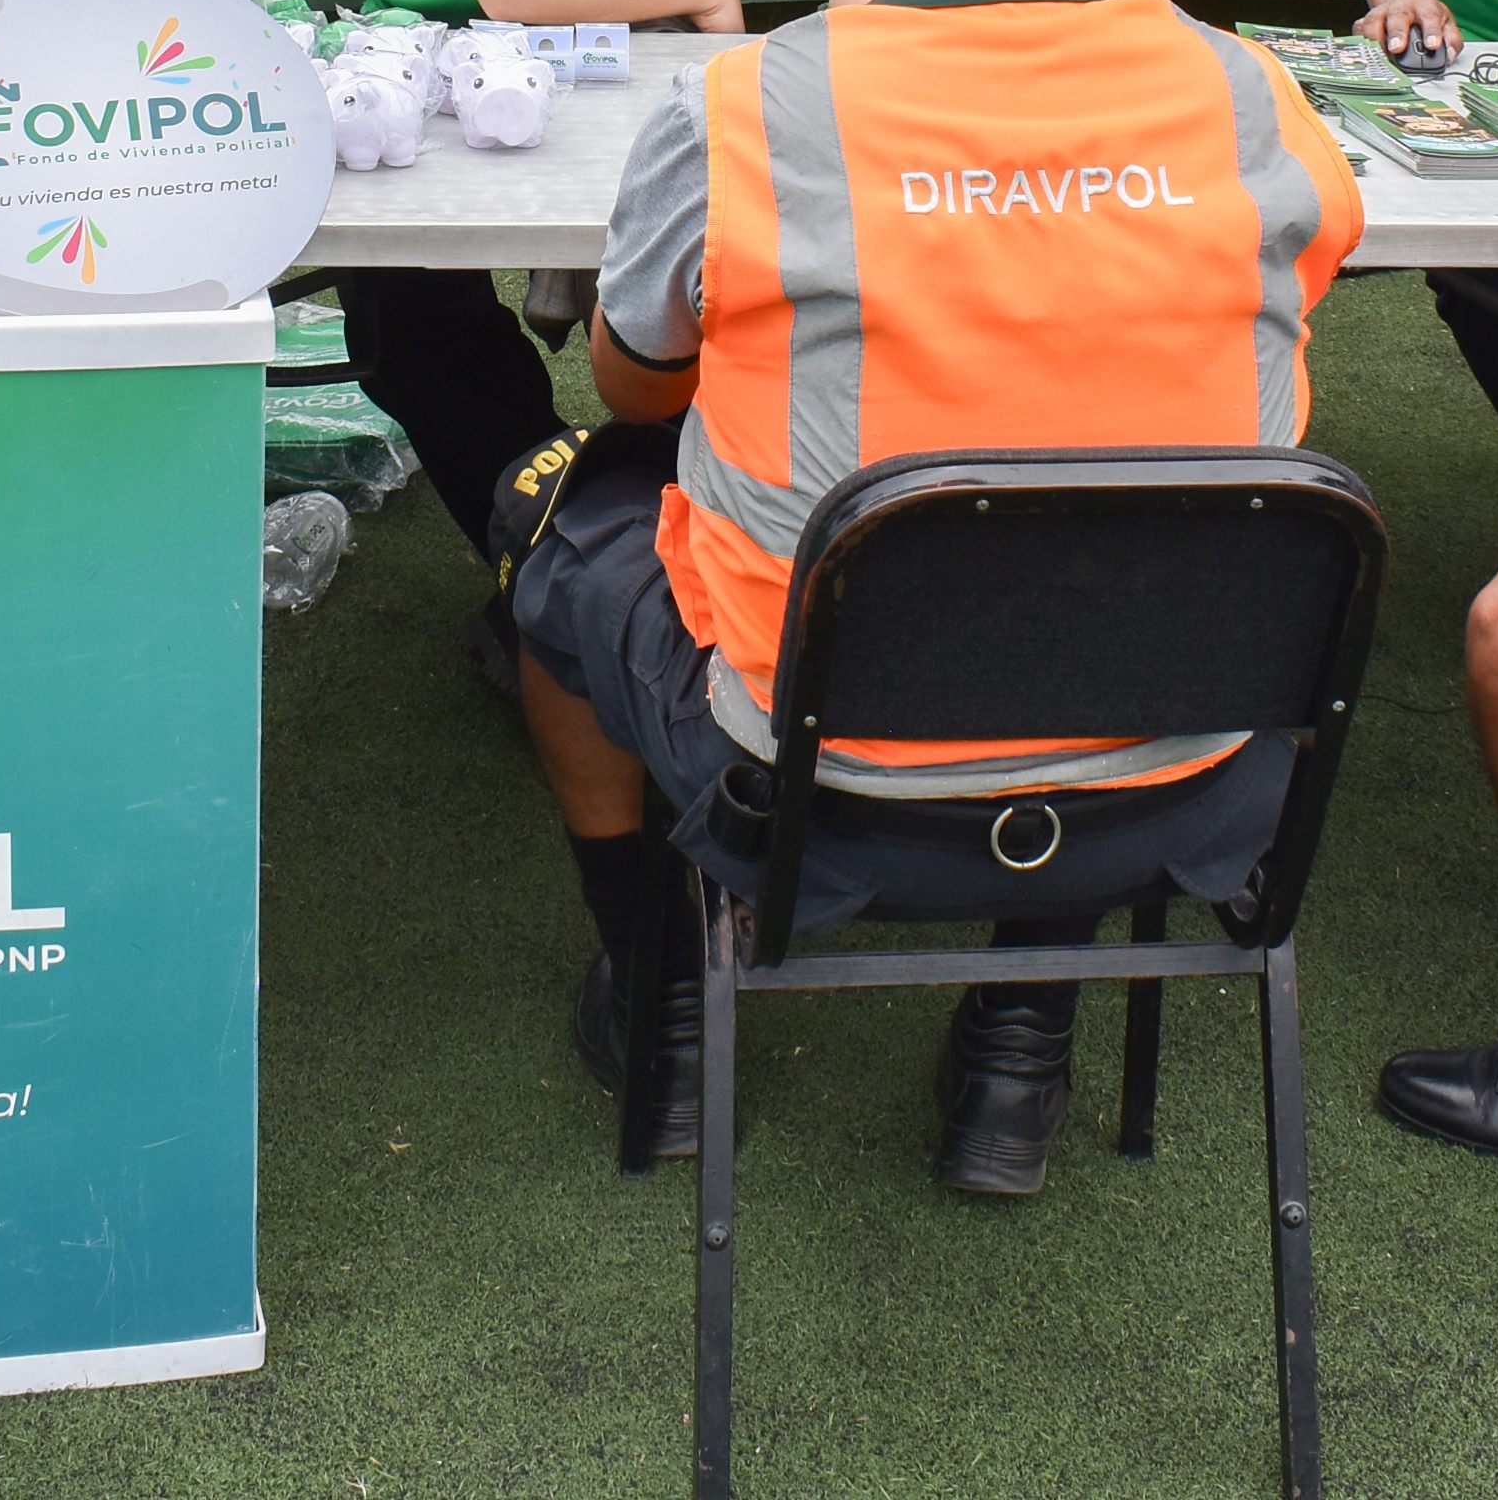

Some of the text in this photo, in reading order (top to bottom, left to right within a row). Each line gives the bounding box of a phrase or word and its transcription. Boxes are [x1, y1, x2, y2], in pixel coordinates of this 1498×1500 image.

[587, 56, 618, 64] FOVIPOL
[17, 137, 291, 166] Fondo de Vivienda Policial
[17, 185, 103, 205] vivienda
[109, 185, 131, 199] es
[137, 177, 214, 198] nuestra
[220, 174, 278, 192] meta!
[900, 164, 1195, 215] DIRAVPOL
